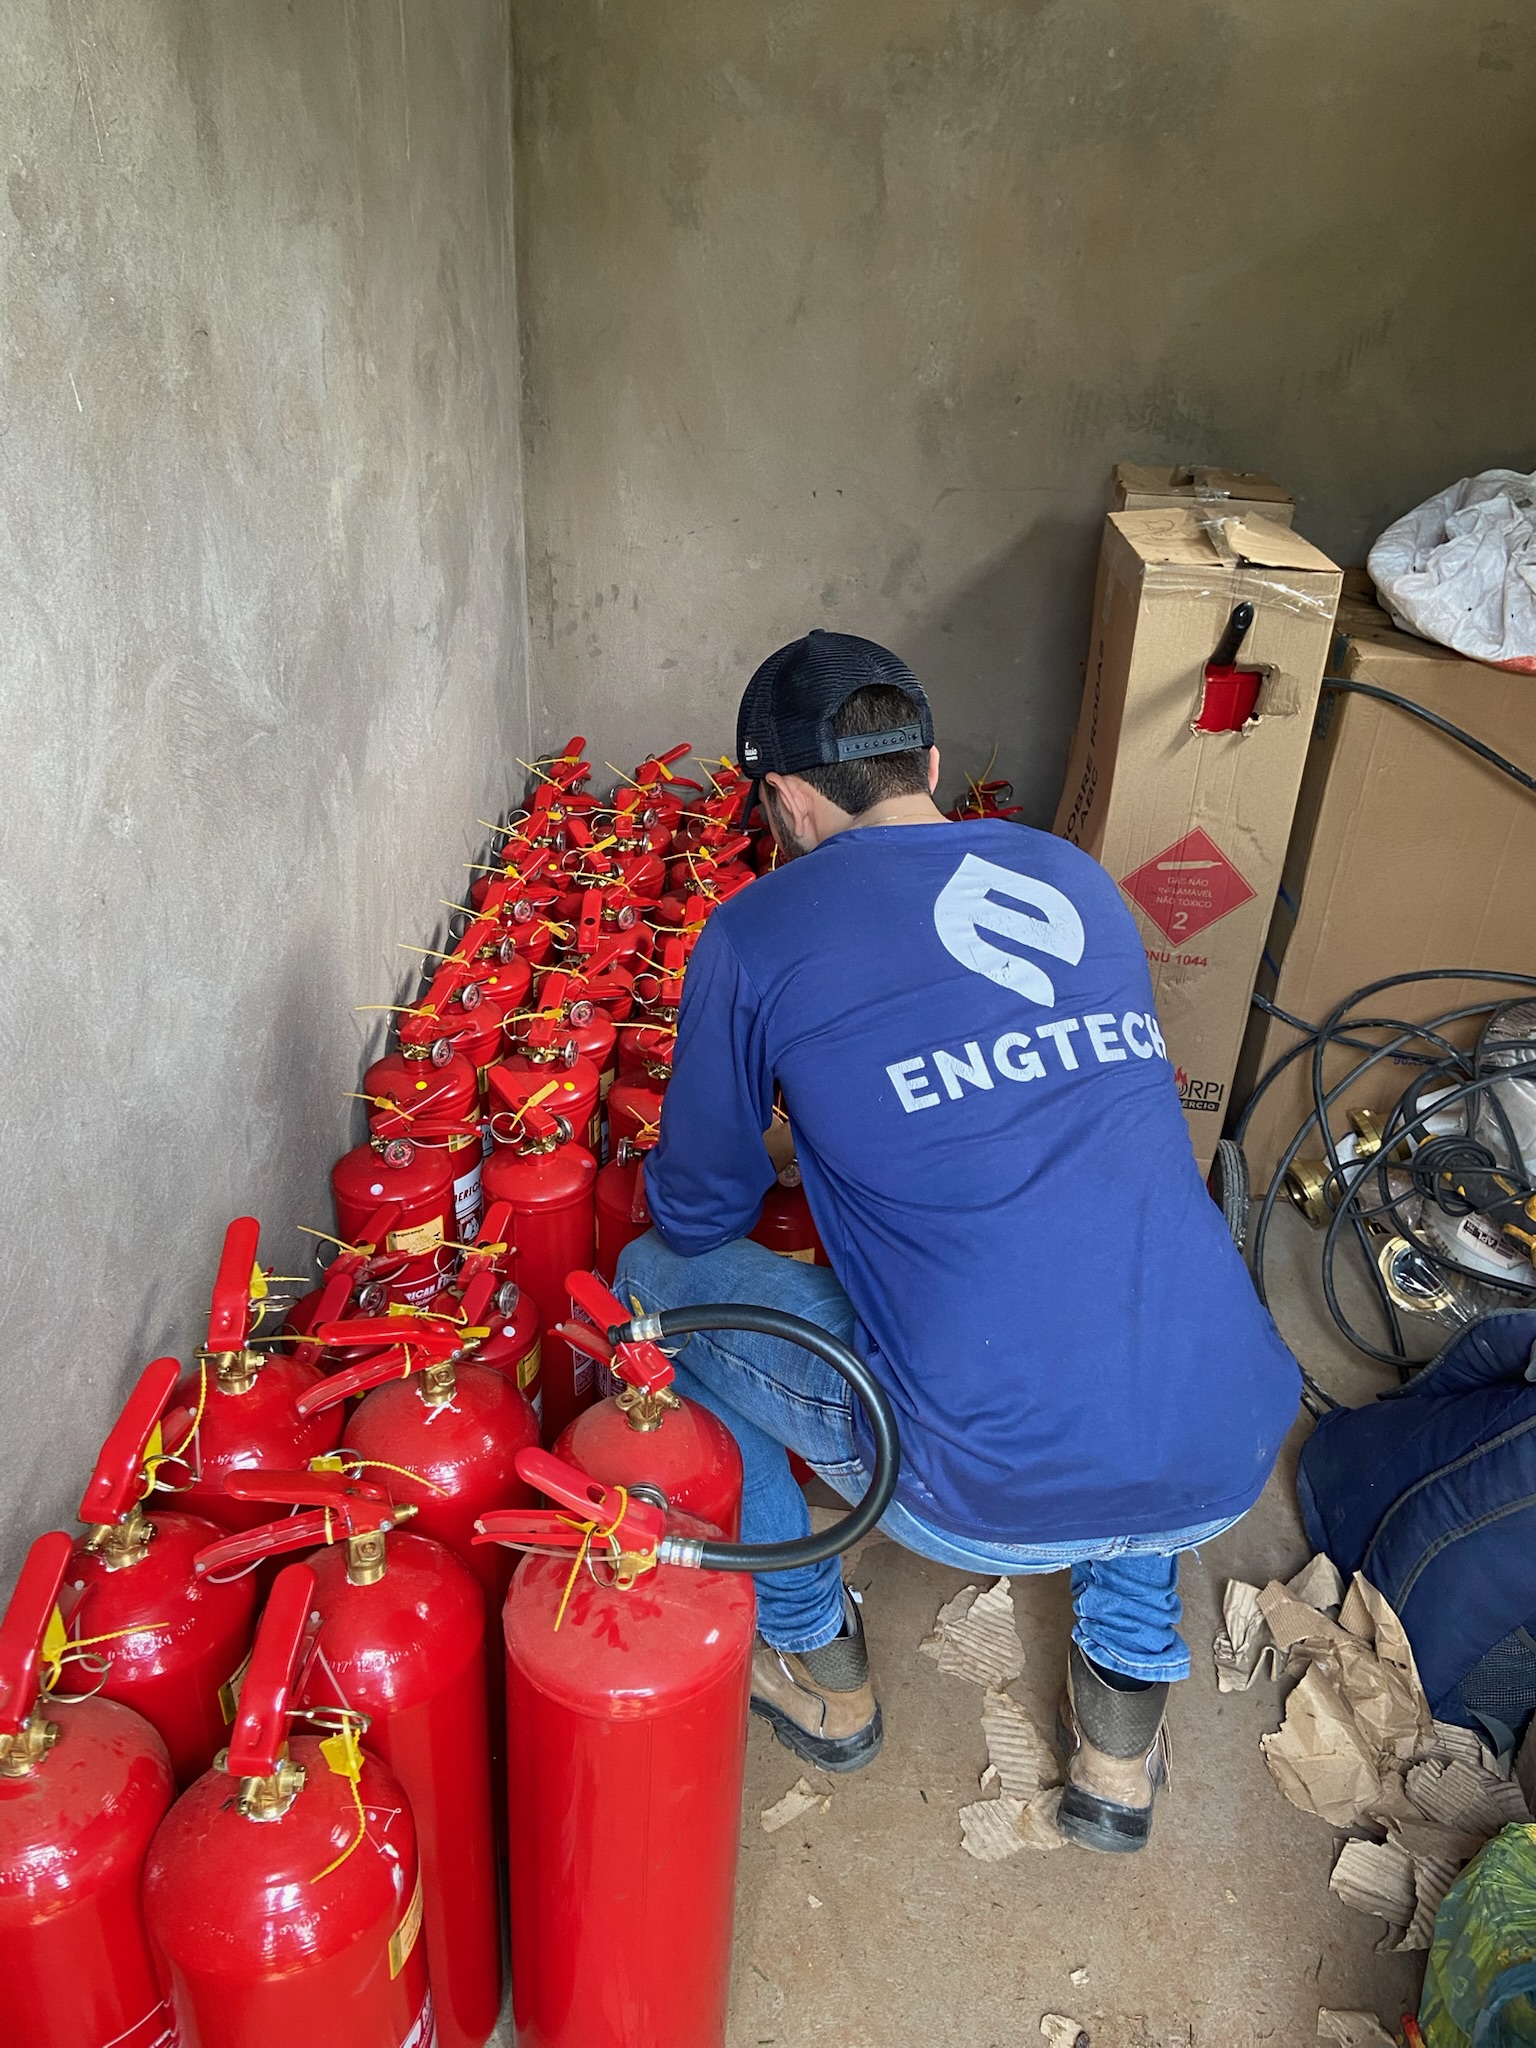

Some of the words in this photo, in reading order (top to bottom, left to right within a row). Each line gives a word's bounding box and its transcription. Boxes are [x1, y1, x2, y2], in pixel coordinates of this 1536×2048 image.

[1080, 767, 1099, 829] ABC
[1172, 911, 1189, 930] 2
[1175, 955, 1208, 967] 1044
[886, 1011, 1168, 1113] ENGTECH
